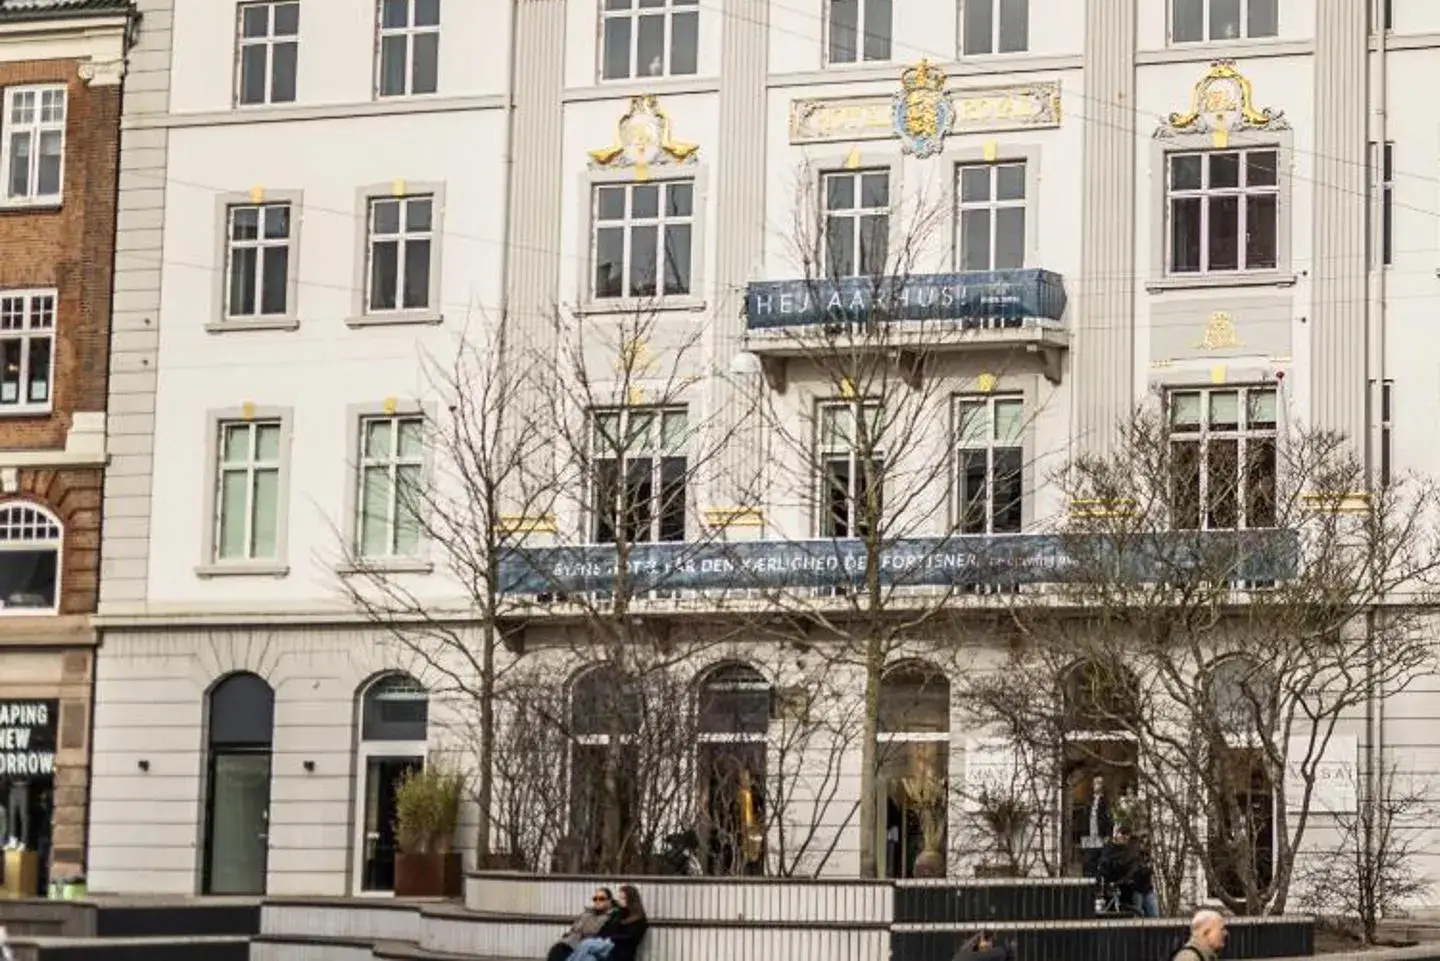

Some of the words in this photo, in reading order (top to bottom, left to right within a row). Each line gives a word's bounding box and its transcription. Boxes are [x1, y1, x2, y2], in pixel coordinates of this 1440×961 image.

[756, 291, 809, 315] HEJ
[702, 559, 734, 572] DEN
[844, 554, 869, 571] DE
[0, 704, 48, 725] APING
[1290, 767, 1352, 780] MSAI
